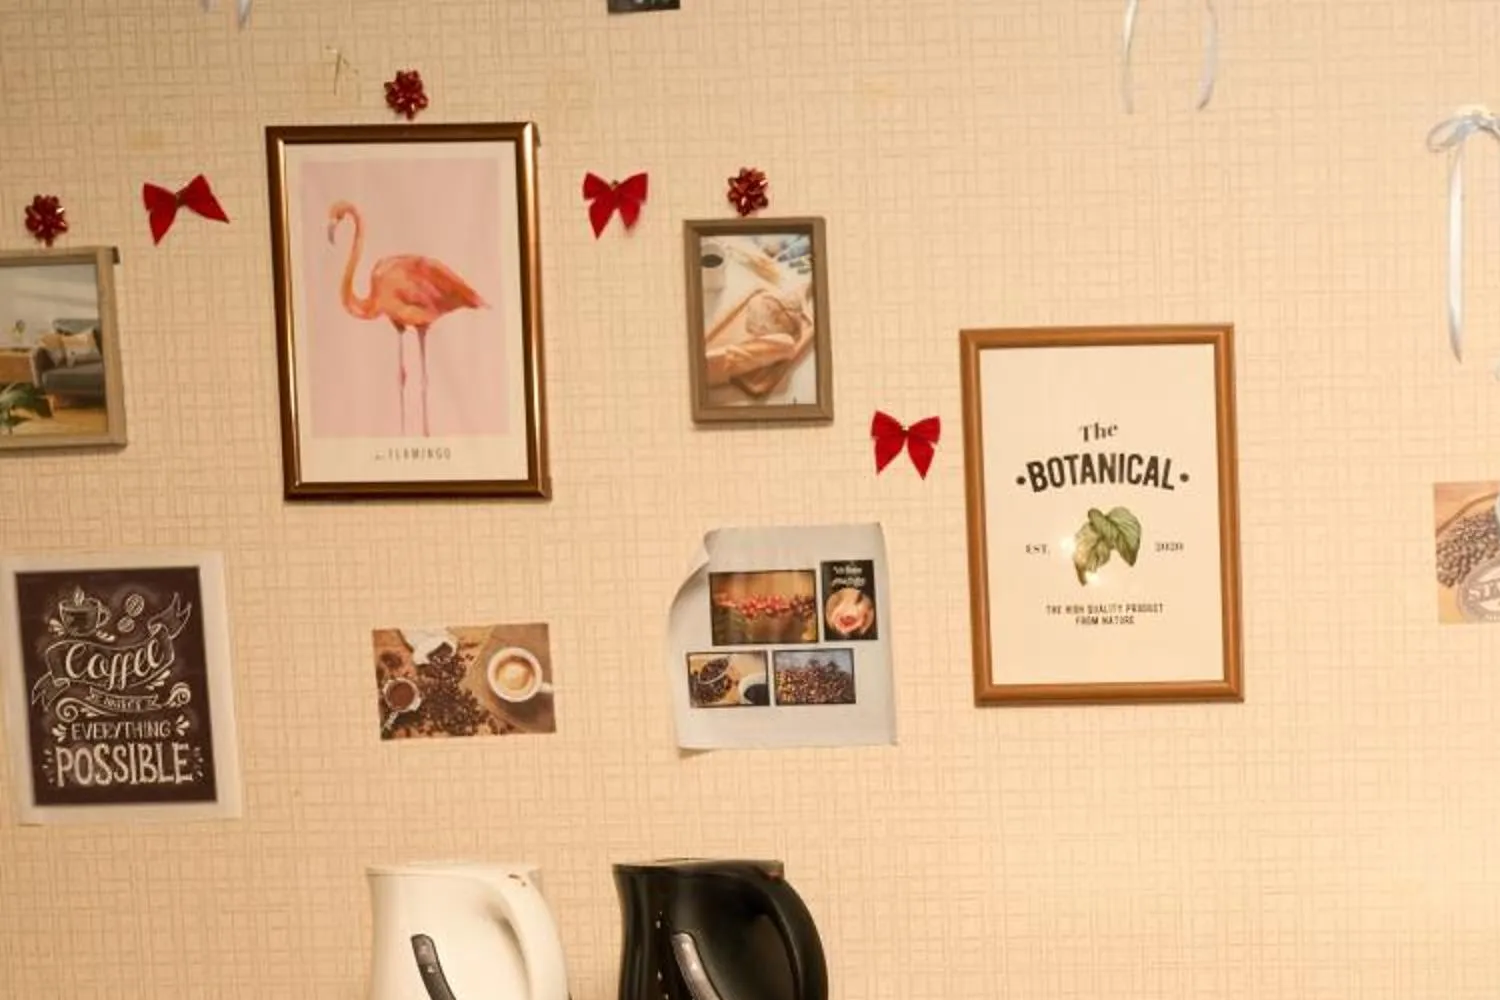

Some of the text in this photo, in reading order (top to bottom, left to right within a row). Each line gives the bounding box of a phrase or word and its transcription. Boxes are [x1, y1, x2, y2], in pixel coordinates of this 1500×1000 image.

[1080, 422, 1118, 442] The
[388, 447, 451, 460] FLAMINGO
[1026, 452, 1175, 492] BOTANICAL
[1088, 604, 1122, 614] QUALITY
[1126, 604, 1163, 613] PRODUCT
[1076, 616, 1134, 625] FROM NATURE
[65, 639, 165, 690] Coffee
[71, 720, 171, 740] EVERYTHING
[55, 742, 193, 787] POSSIBLE
